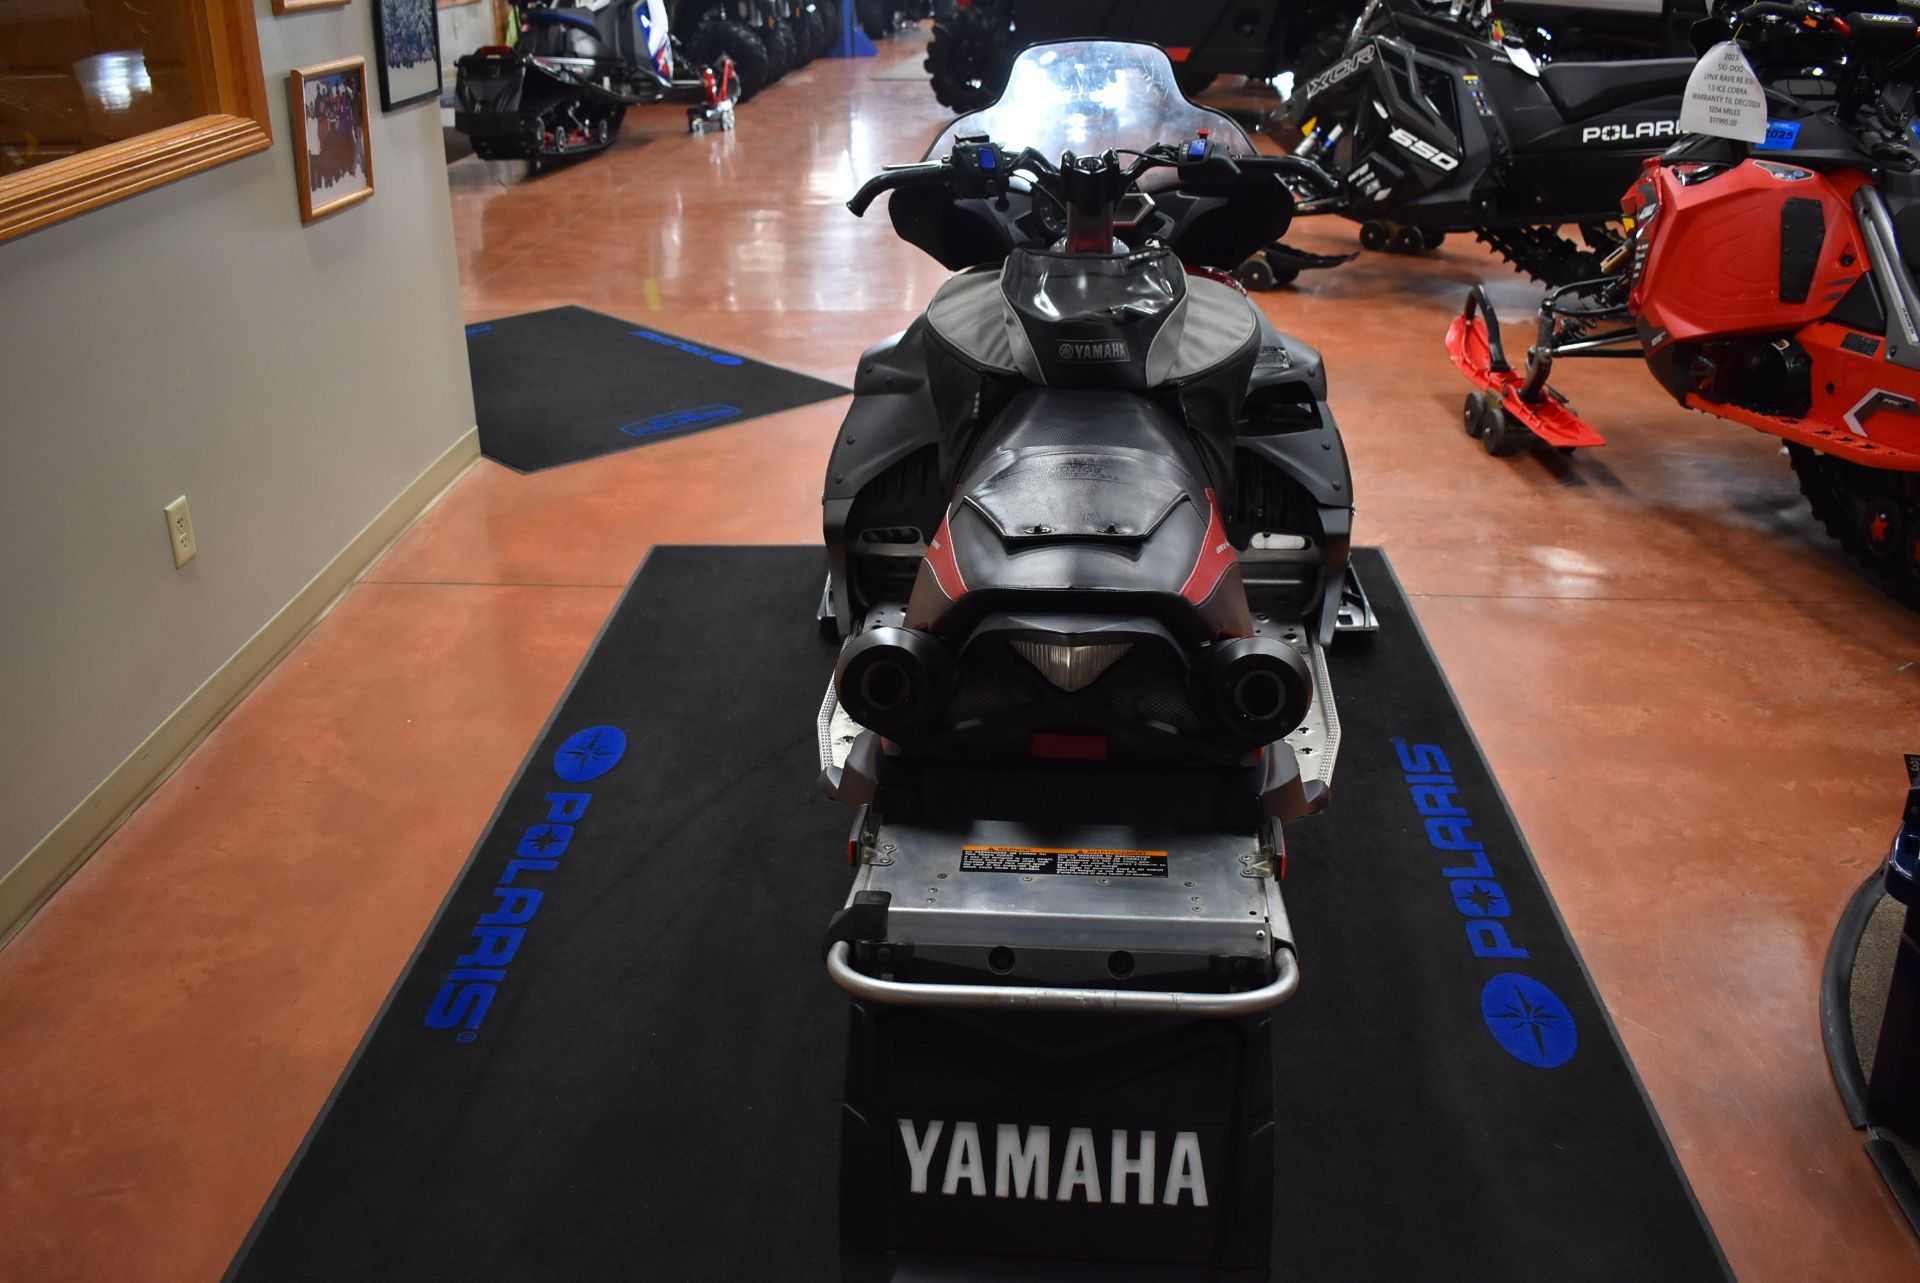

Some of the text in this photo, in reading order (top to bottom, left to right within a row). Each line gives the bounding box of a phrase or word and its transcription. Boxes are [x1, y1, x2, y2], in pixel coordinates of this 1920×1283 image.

[1872, 14, 1900, 22] LYNX
[1724, 53, 1739, 61] 2023
[1718, 64, 1744, 72] SKI-DOO
[1720, 74, 1735, 83] RAVE
[1736, 76, 1744, 84] RE
[1717, 84, 1726, 93] ICE
[1727, 85, 1748, 95] COBRA
[1692, 93, 1724, 103] WARRANTY
[1725, 97, 1733, 105] TIL
[1709, 105, 1741, 117] 1204 MILES
[1582, 119, 1690, 143] POLARI
[1388, 128, 1459, 171] 650
[1075, 342, 1127, 359] YAMAHA
[1394, 740, 1531, 959] POLARIS
[424, 792, 593, 1030] POLARIS
[898, 1118, 1209, 1207] YAMAHA
